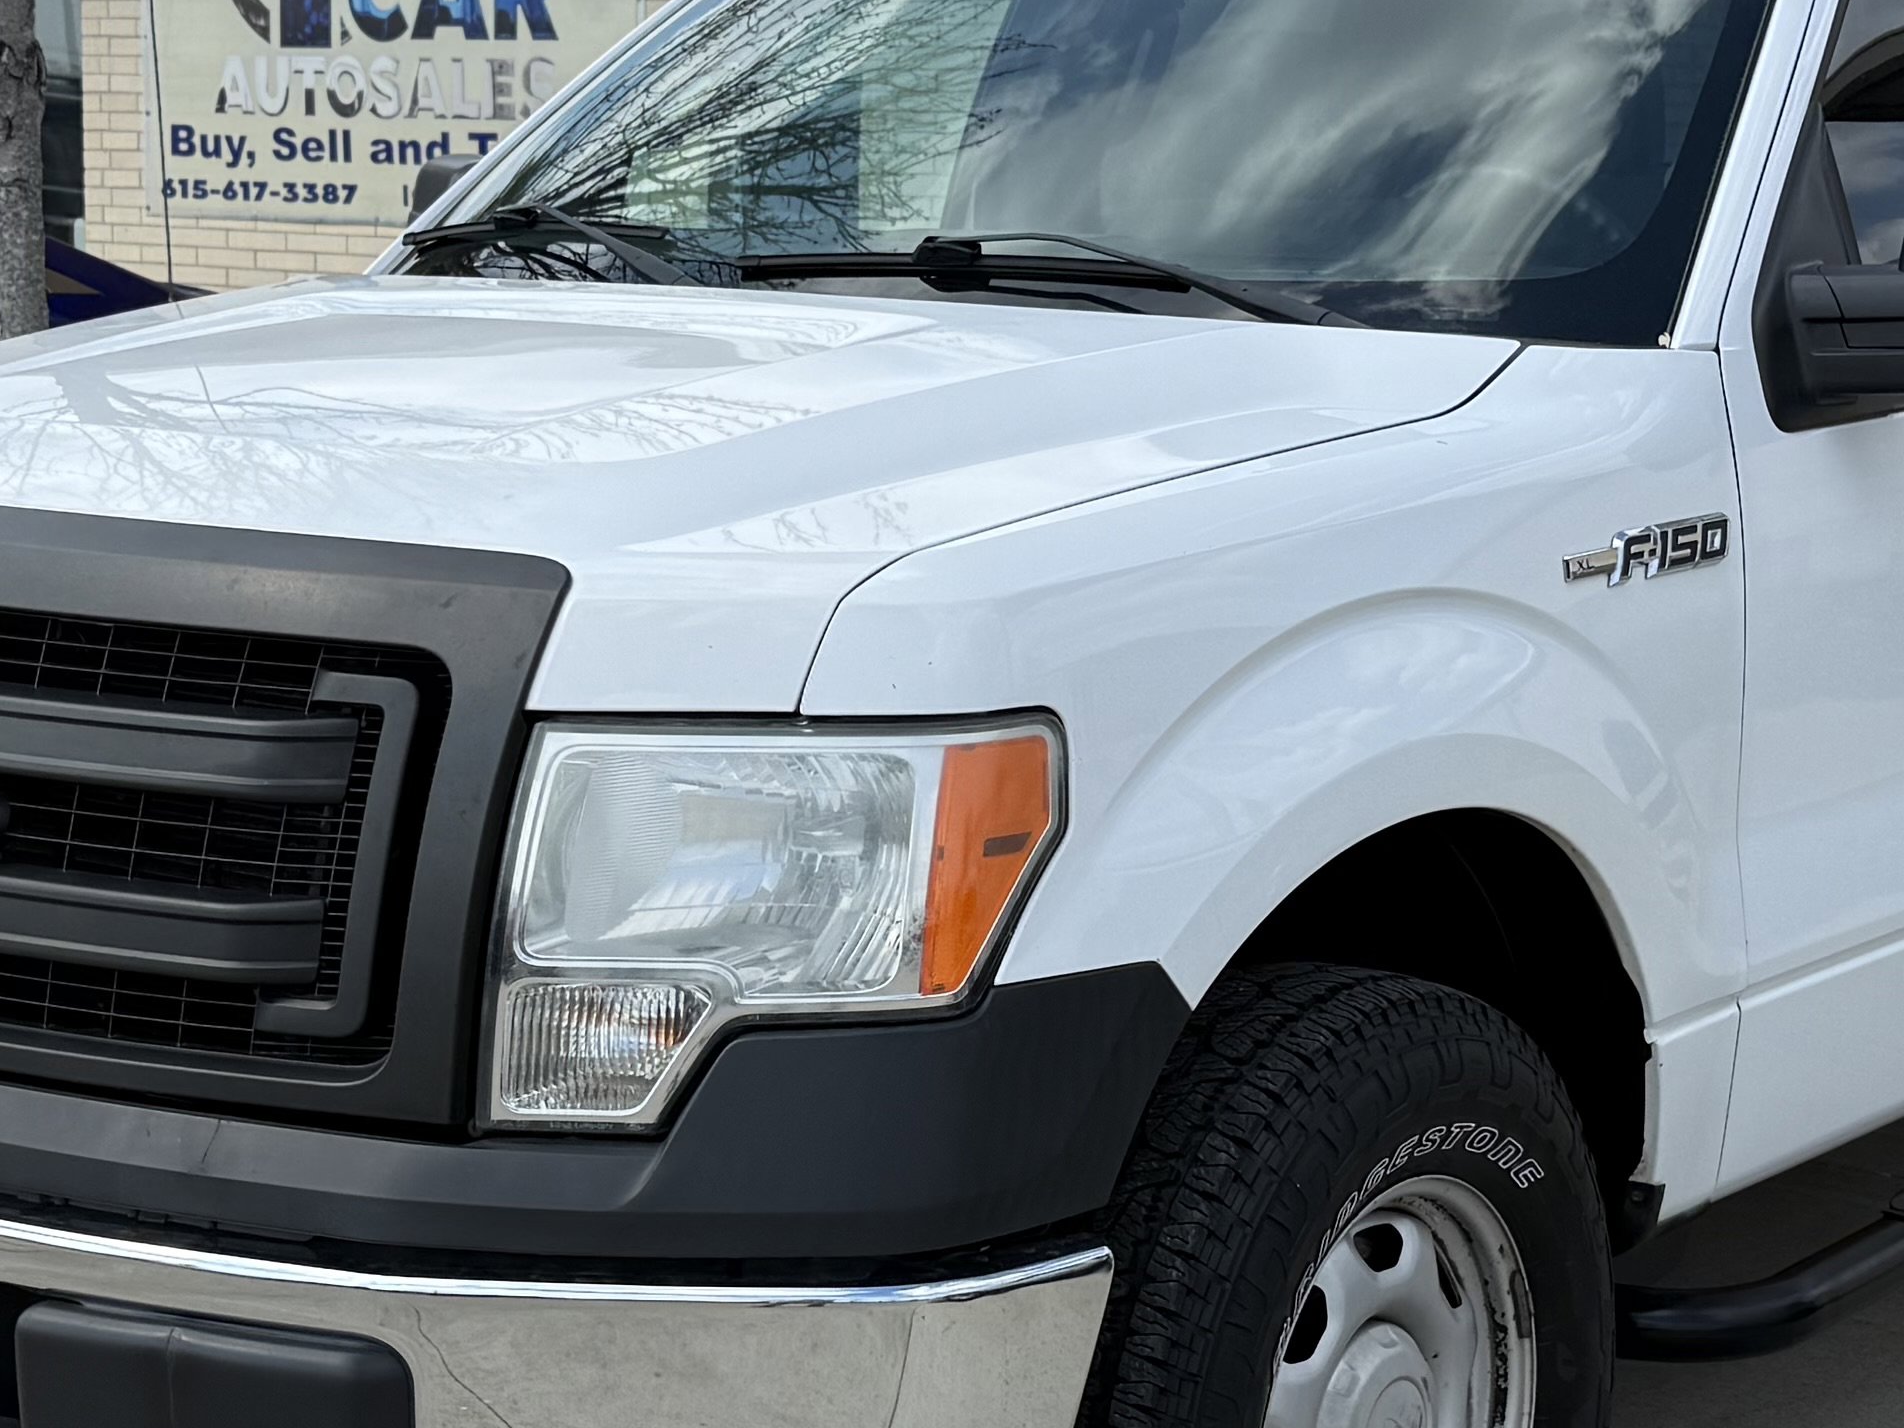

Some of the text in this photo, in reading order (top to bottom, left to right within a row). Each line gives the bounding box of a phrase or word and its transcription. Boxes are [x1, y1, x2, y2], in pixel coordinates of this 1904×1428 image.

[215, 56, 557, 121] AUTOSALES
[171, 125, 256, 167] Buy,
[272, 127, 352, 163] Sell
[370, 132, 450, 165] and
[162, 178, 358, 205] 615-617-3387
